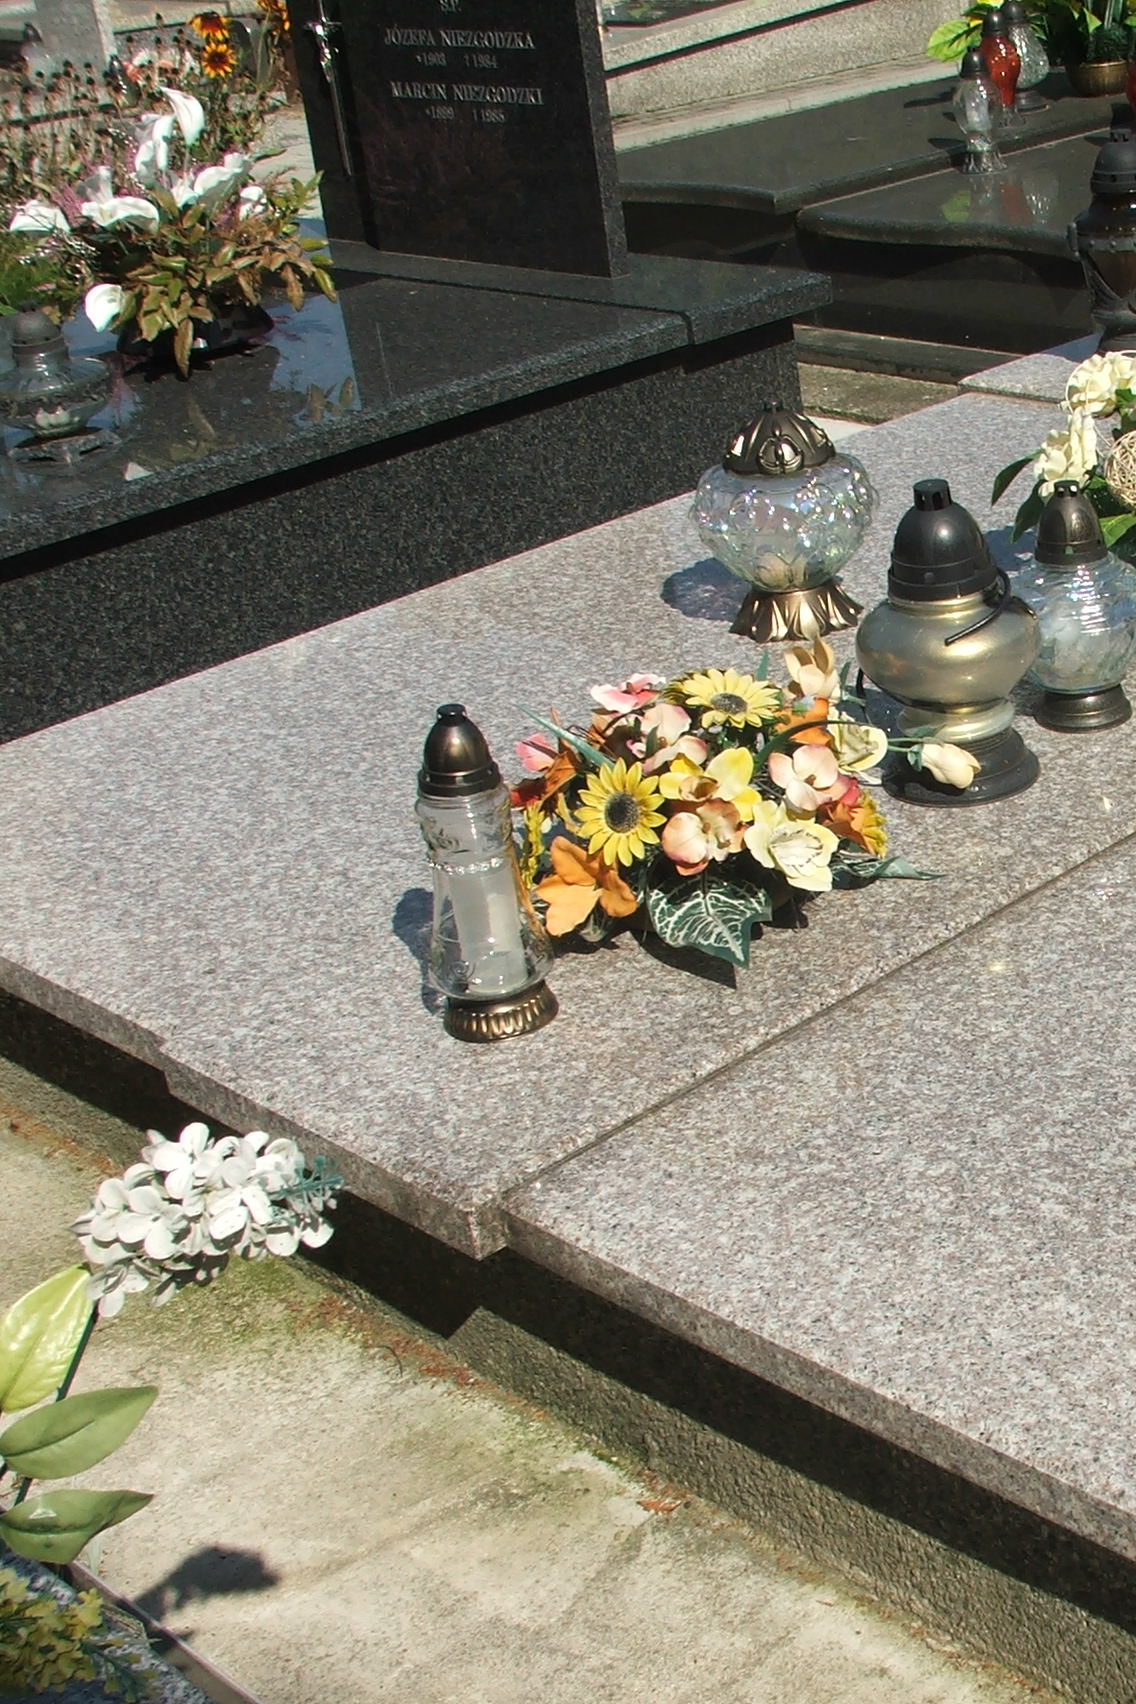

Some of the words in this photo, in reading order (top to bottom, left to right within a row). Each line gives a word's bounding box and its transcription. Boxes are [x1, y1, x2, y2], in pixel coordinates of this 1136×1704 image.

[384, 23, 437, 46] JÓZEFA
[439, 29, 536, 50] NIEZGODZKA
[389, 80, 448, 100] MARCIN
[451, 84, 544, 105] NIEZGODZKI
